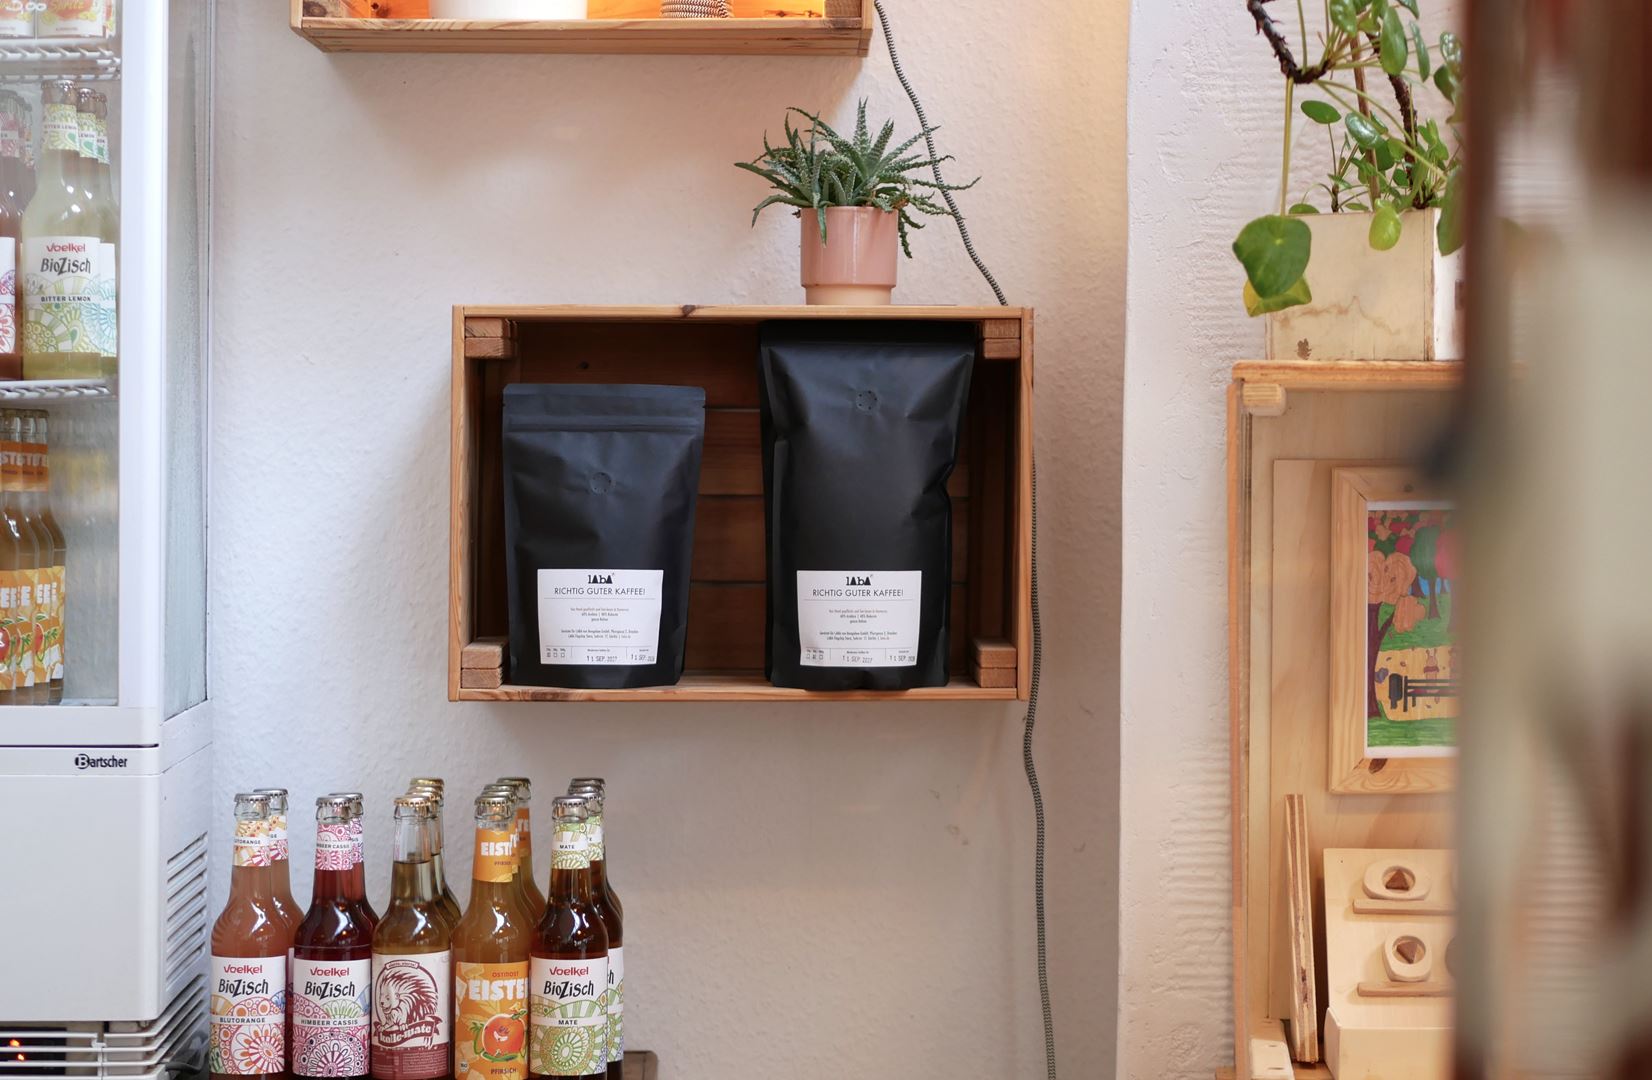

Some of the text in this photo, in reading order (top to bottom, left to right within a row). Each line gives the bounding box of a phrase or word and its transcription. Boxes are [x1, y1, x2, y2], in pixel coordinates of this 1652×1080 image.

[40, 257, 91, 276] BioZisch
[554, 587, 646, 596] RICHTIG GUTER KAFFEE!
[812, 589, 904, 597] RICHTIG GUTER KAFFEE!
[74, 753, 128, 770] Bartscher
[223, 964, 263, 975] Voelkel
[310, 967, 350, 977] Voelkel
[549, 966, 589, 977] Voelkel
[218, 979, 269, 998] BioZisch
[304, 981, 356, 1000] BioZisch
[543, 980, 594, 999] BioZisch
